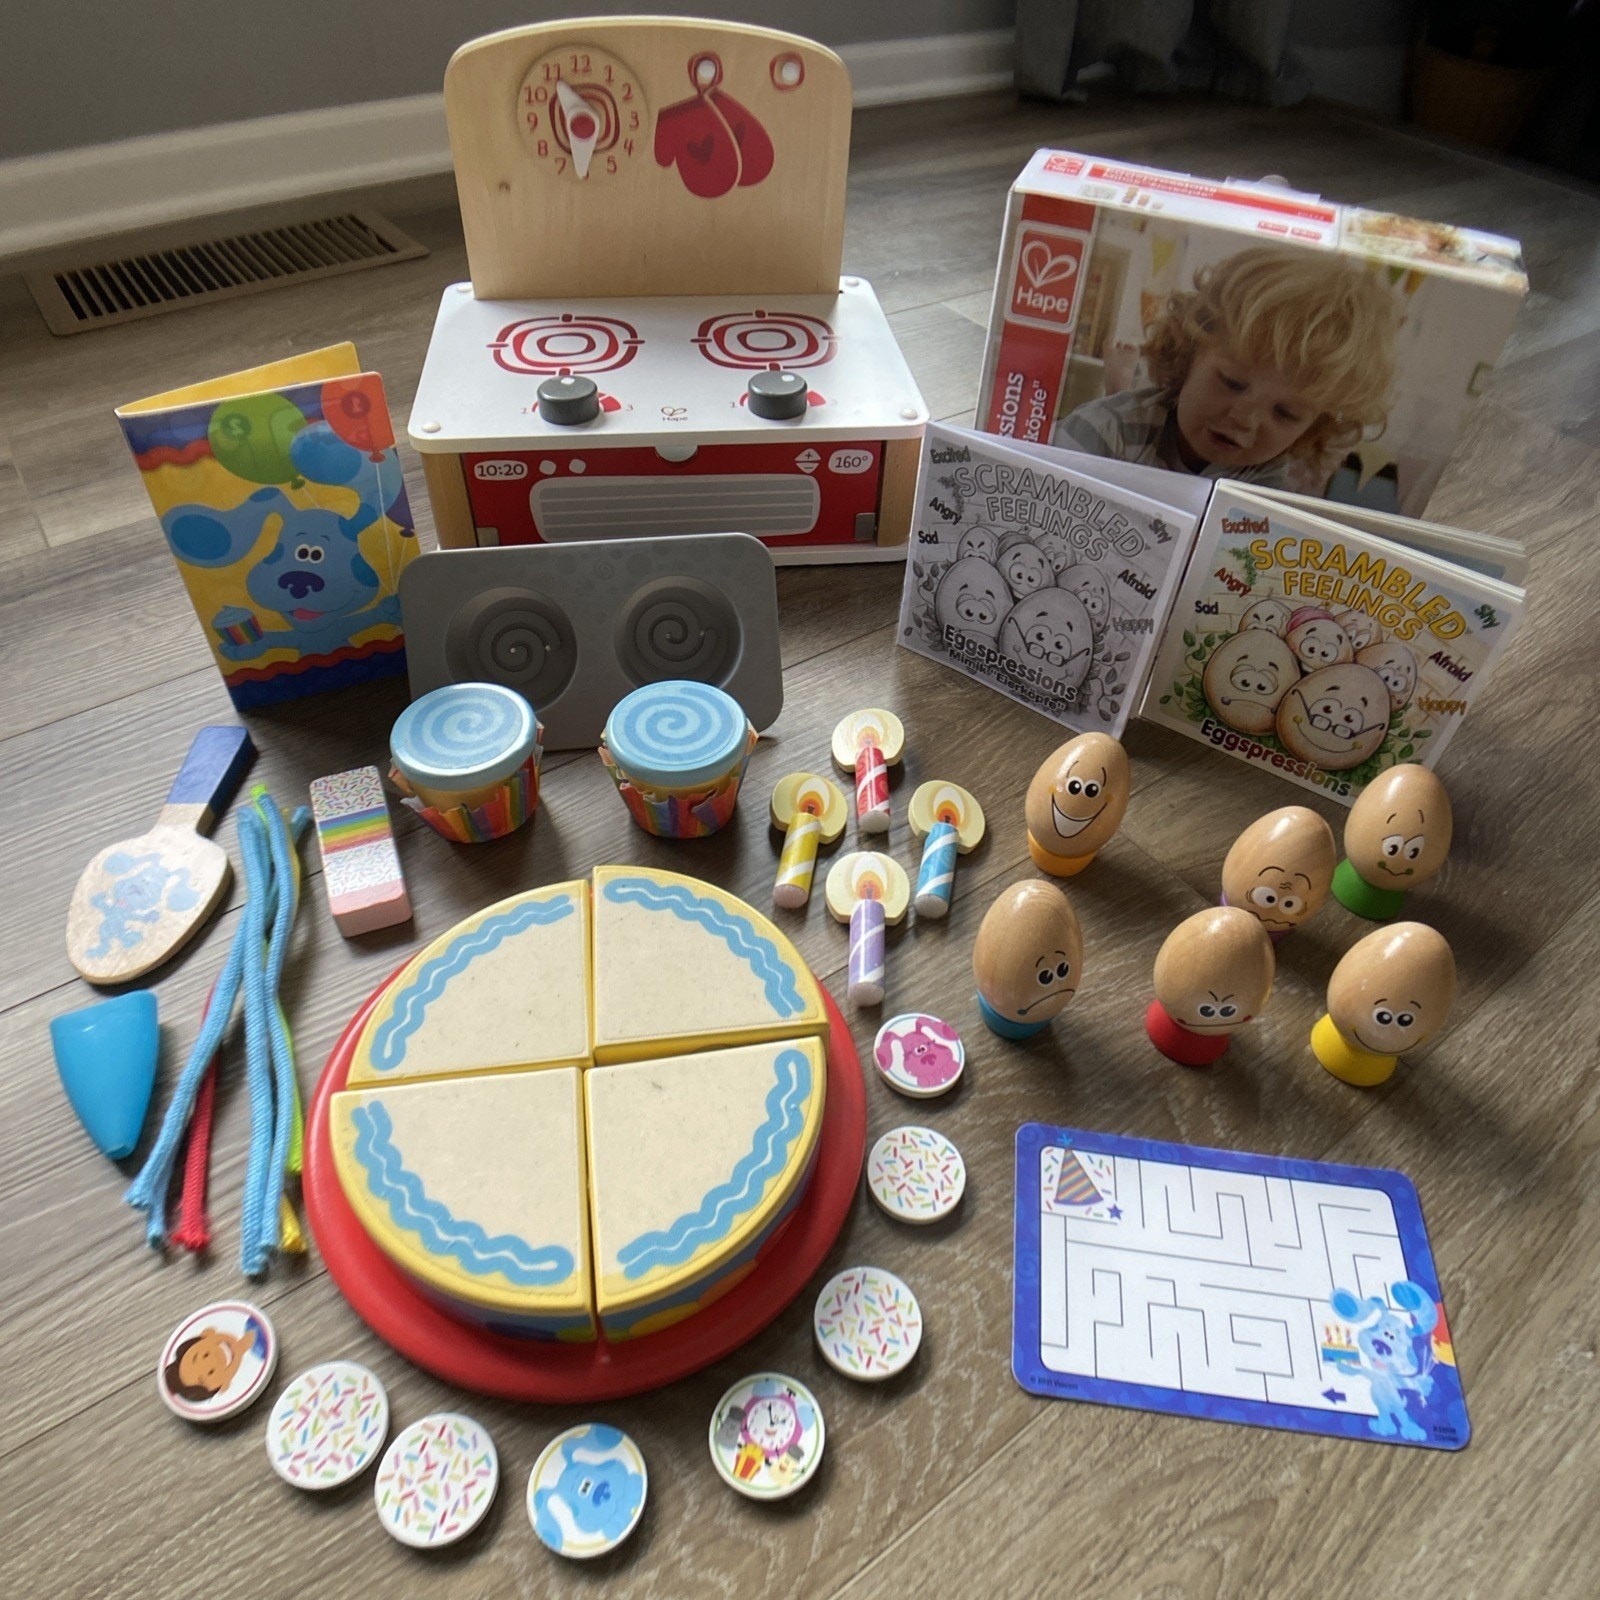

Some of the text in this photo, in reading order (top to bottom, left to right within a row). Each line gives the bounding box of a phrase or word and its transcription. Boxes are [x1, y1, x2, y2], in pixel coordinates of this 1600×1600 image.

[542, 63, 562, 81] 11
[570, 54, 592, 74] 12
[604, 64, 614, 83] 1
[524, 86, 548, 104] 10
[622, 83, 633, 101] 2
[527, 112, 538, 133] 9
[629, 111, 640, 131] 3
[537, 139, 549, 157] 8
[623, 138, 634, 156] 4
[555, 157, 567, 176] 7
[607, 155, 618, 174] 5
[1016, 285, 1069, 314] Hape
[835, 455, 868, 469] 160°
[930, 445, 971, 464] Excited
[477, 463, 525, 477] 10:20
[929, 496, 962, 526] Angry
[954, 463, 1145, 558] SCRAMBLED
[985, 496, 1109, 561] FEELINGS
[1148, 518, 1173, 544] Shy
[1221, 516, 1270, 534] Excited
[918, 530, 939, 544] Sad
[1117, 569, 1157, 600] Afraid
[1214, 567, 1252, 598] Angry
[1250, 537, 1466, 640] SCRAMBLED
[1194, 600, 1219, 615] Sad
[1284, 570, 1423, 641] FEELINGS
[1112, 616, 1154, 635] Happy
[944, 624, 1077, 701] Eggspressions
[948, 648, 987, 675] Mimik
[1428, 651, 1473, 682] Afraid
[1417, 696, 1467, 715] Happy
[1200, 718, 1351, 796] Eggspressions
